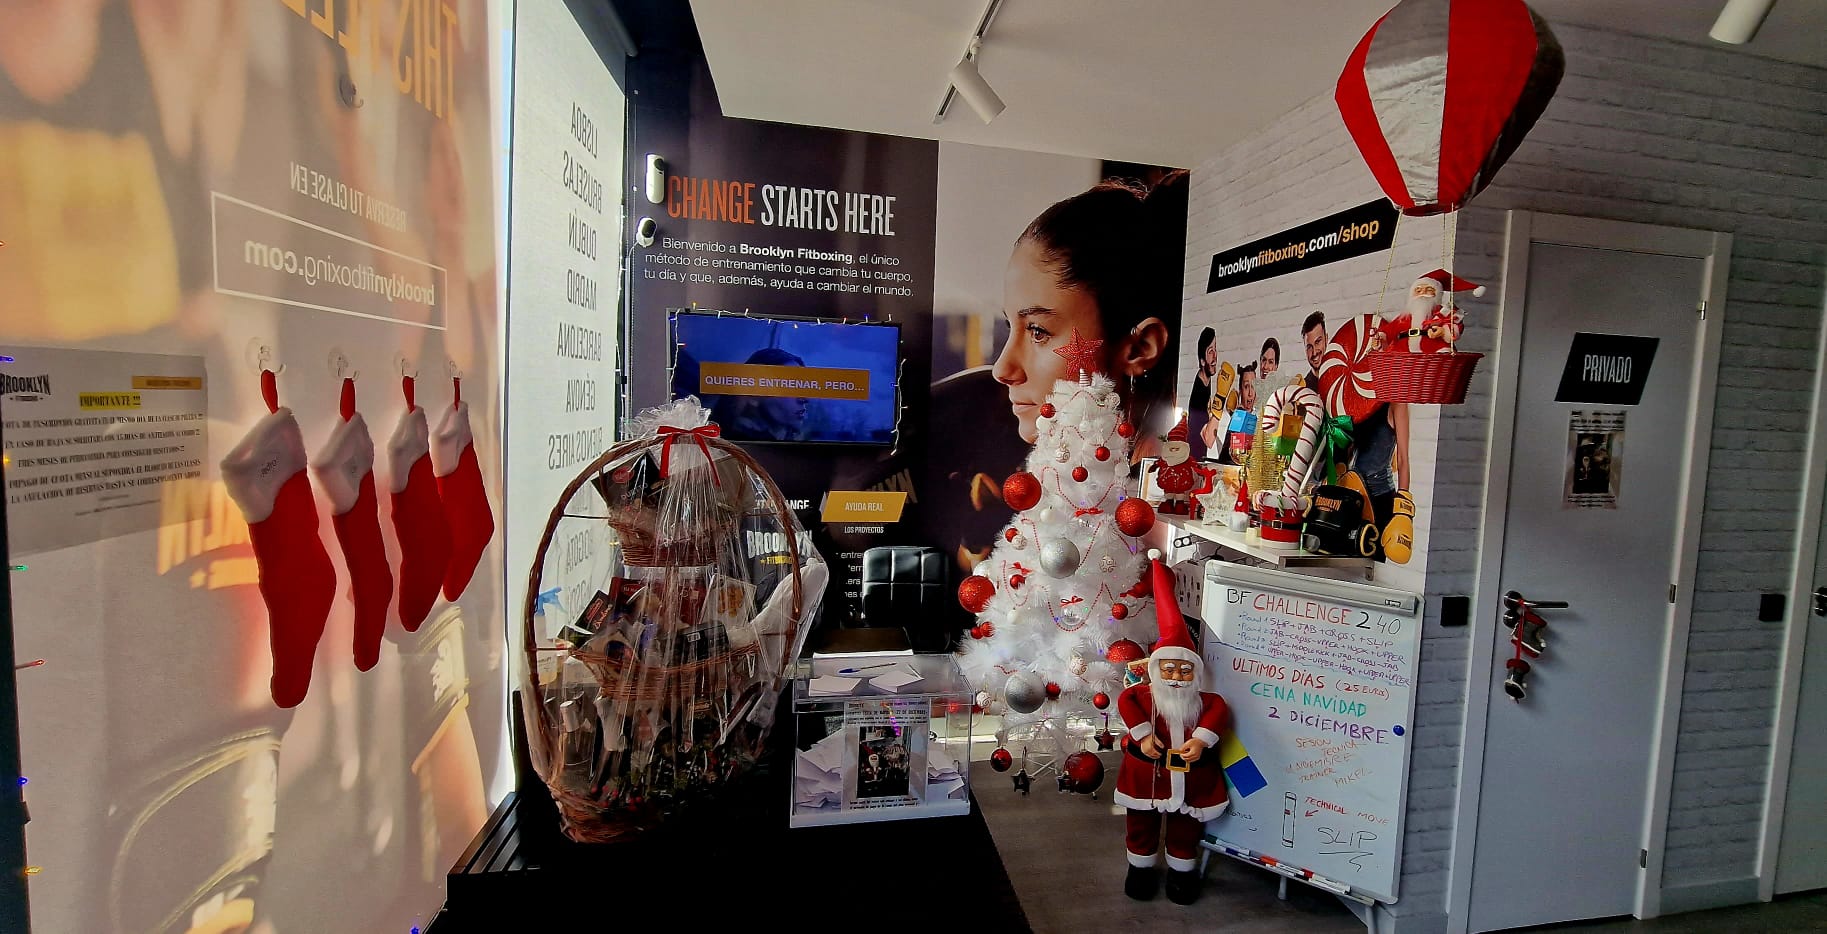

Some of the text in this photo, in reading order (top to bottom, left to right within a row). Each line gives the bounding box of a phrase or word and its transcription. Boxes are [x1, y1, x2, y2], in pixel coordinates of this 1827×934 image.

[667, 175, 897, 237] CHANGE STARTS HERE
[662, 237, 900, 266] Bienvenido a Brooklyn Fitboxing, el único
[1218, 219, 1380, 278] brooklynfitboxing.com/shop
[644, 268, 914, 297] tu día y que, además, ayuda a cambiar el mundo.
[645, 253, 914, 284] método de entrenamiento que cambia tu cuerpo,
[704, 375, 865, 392] QUIERES ENTRENAR, PERO...
[1582, 354, 1632, 384] PRIVADO
[80, 395, 131, 407] IMPORTANTE
[845, 502, 885, 512] AYUDA REAL
[844, 526, 885, 534] LOS PROYECTOS
[1227, 588, 1252, 604] BF
[1253, 593, 1353, 626] CHALLENGE
[1250, 681, 1368, 718] CENA NAVIDAD
[1267, 706, 1281, 719] 2
[1304, 795, 1390, 826] TECHNICAL MOVE
[1317, 826, 1378, 849] SLIP
